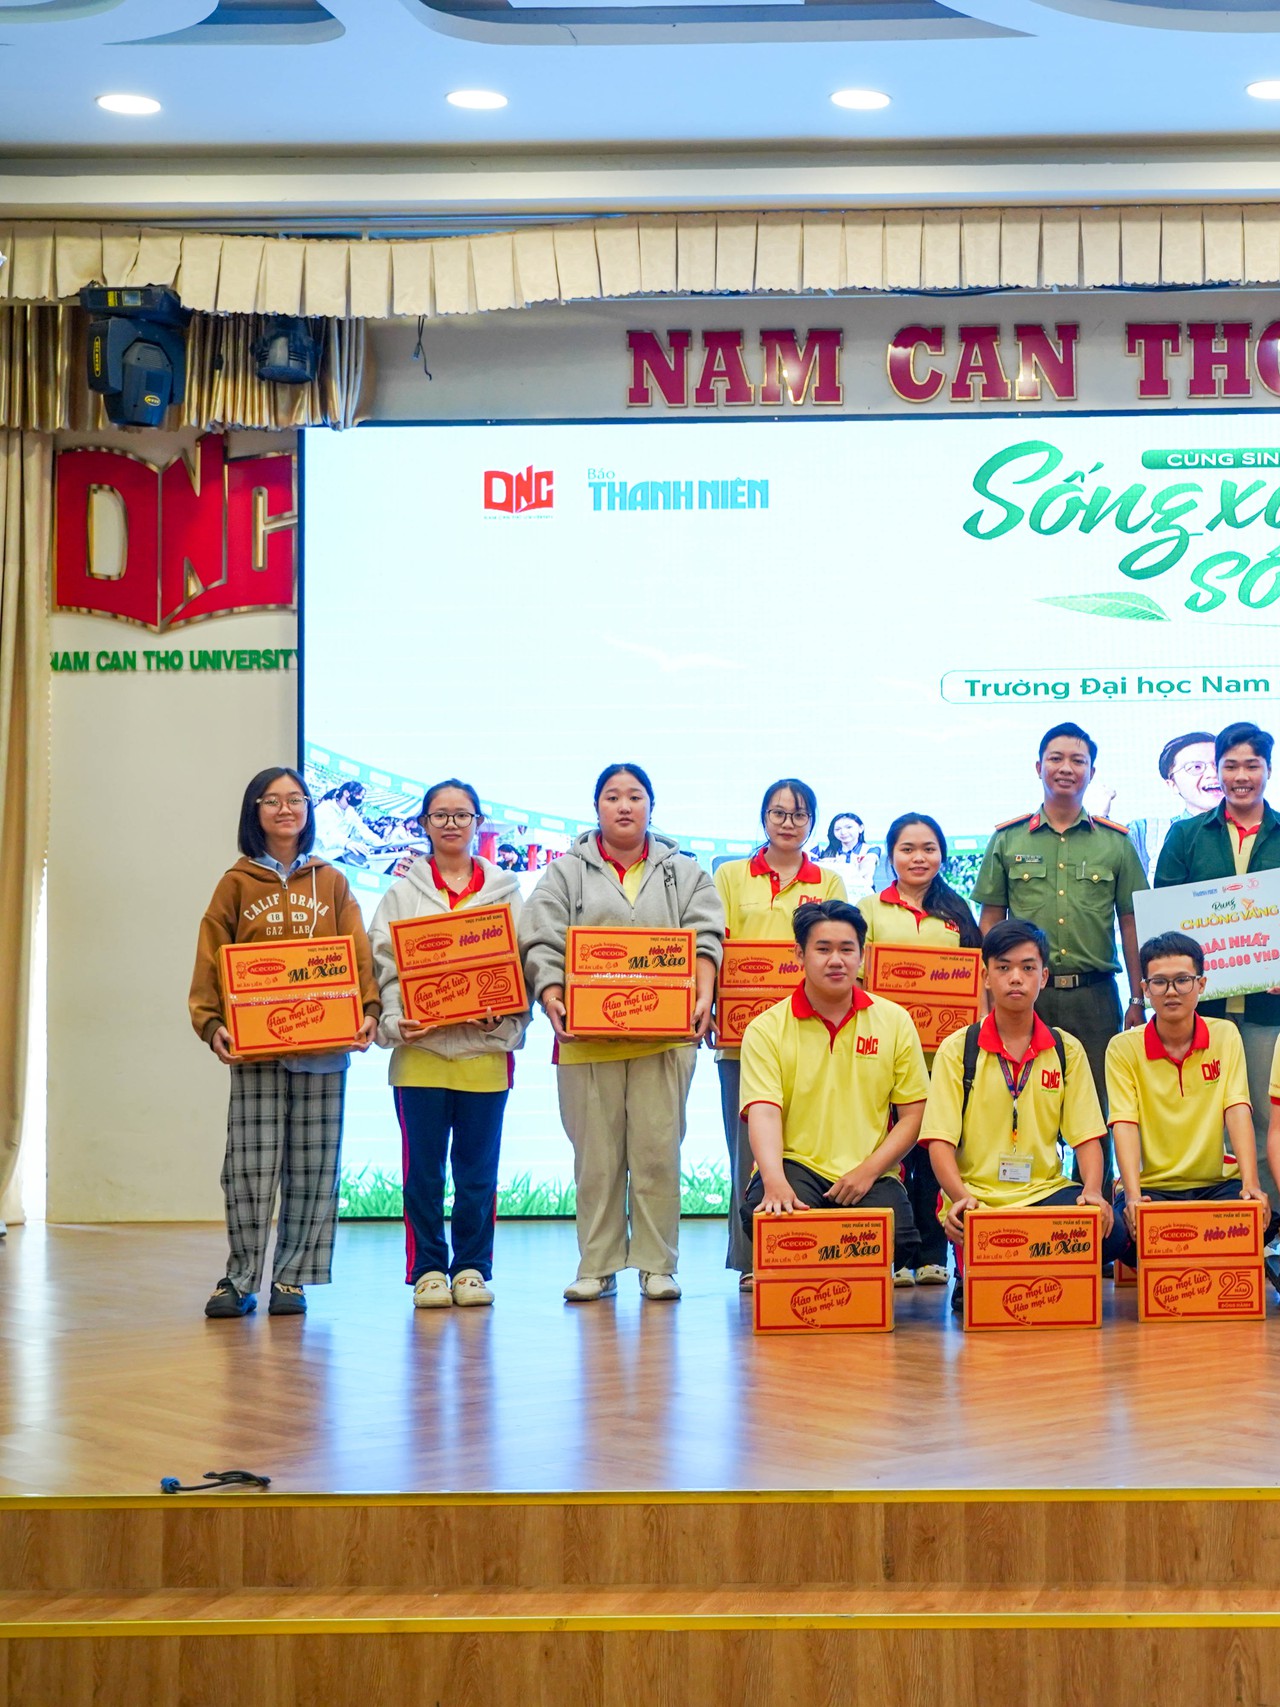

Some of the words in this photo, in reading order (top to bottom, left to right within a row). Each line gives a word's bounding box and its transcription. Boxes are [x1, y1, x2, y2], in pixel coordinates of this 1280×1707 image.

[627, 327, 844, 407] NAM
[887, 322, 1081, 404] CAN
[1166, 449, 1236, 467] CÙNG
[587, 467, 615, 480] Báo
[484, 464, 553, 513] DNC
[588, 481, 693, 511] THANH
[698, 477, 769, 510] NIÊN
[962, 440, 1204, 580] Sống
[52, 431, 297, 634] DNC
[96, 651, 137, 671] CAN
[143, 650, 183, 671] THO
[964, 676, 1071, 700] Trường
[1079, 674, 1128, 697] Đại
[1137, 673, 1192, 697] học
[1201, 674, 1272, 694] Nam
[1212, 897, 1237, 911] Rung
[459, 932, 480, 947] Hảo
[482, 925, 503, 940] Hảo
[1228, 931, 1270, 949] NHẤT
[628, 956, 650, 970] Mì
[652, 954, 685, 968] Xào
[778, 962, 799, 974] Hảo
[288, 965, 311, 983] Mì
[312, 963, 347, 980] Xào
[930, 968, 950, 981] Hảo
[951, 966, 971, 979] Hảo
[477, 968, 511, 999] 25
[856, 1036, 879, 1055] DNC
[1042, 1068, 1061, 1090] DNC
[1201, 1059, 1221, 1081] DNC
[1204, 1227, 1226, 1242] Hảo
[1227, 1223, 1250, 1238] Hảo
[818, 1246, 842, 1261] Mì
[844, 1242, 881, 1257] Xào
[1029, 1242, 1053, 1258] Mì
[1055, 1239, 1091, 1255] Xào
[1218, 1271, 1253, 1300] 25
